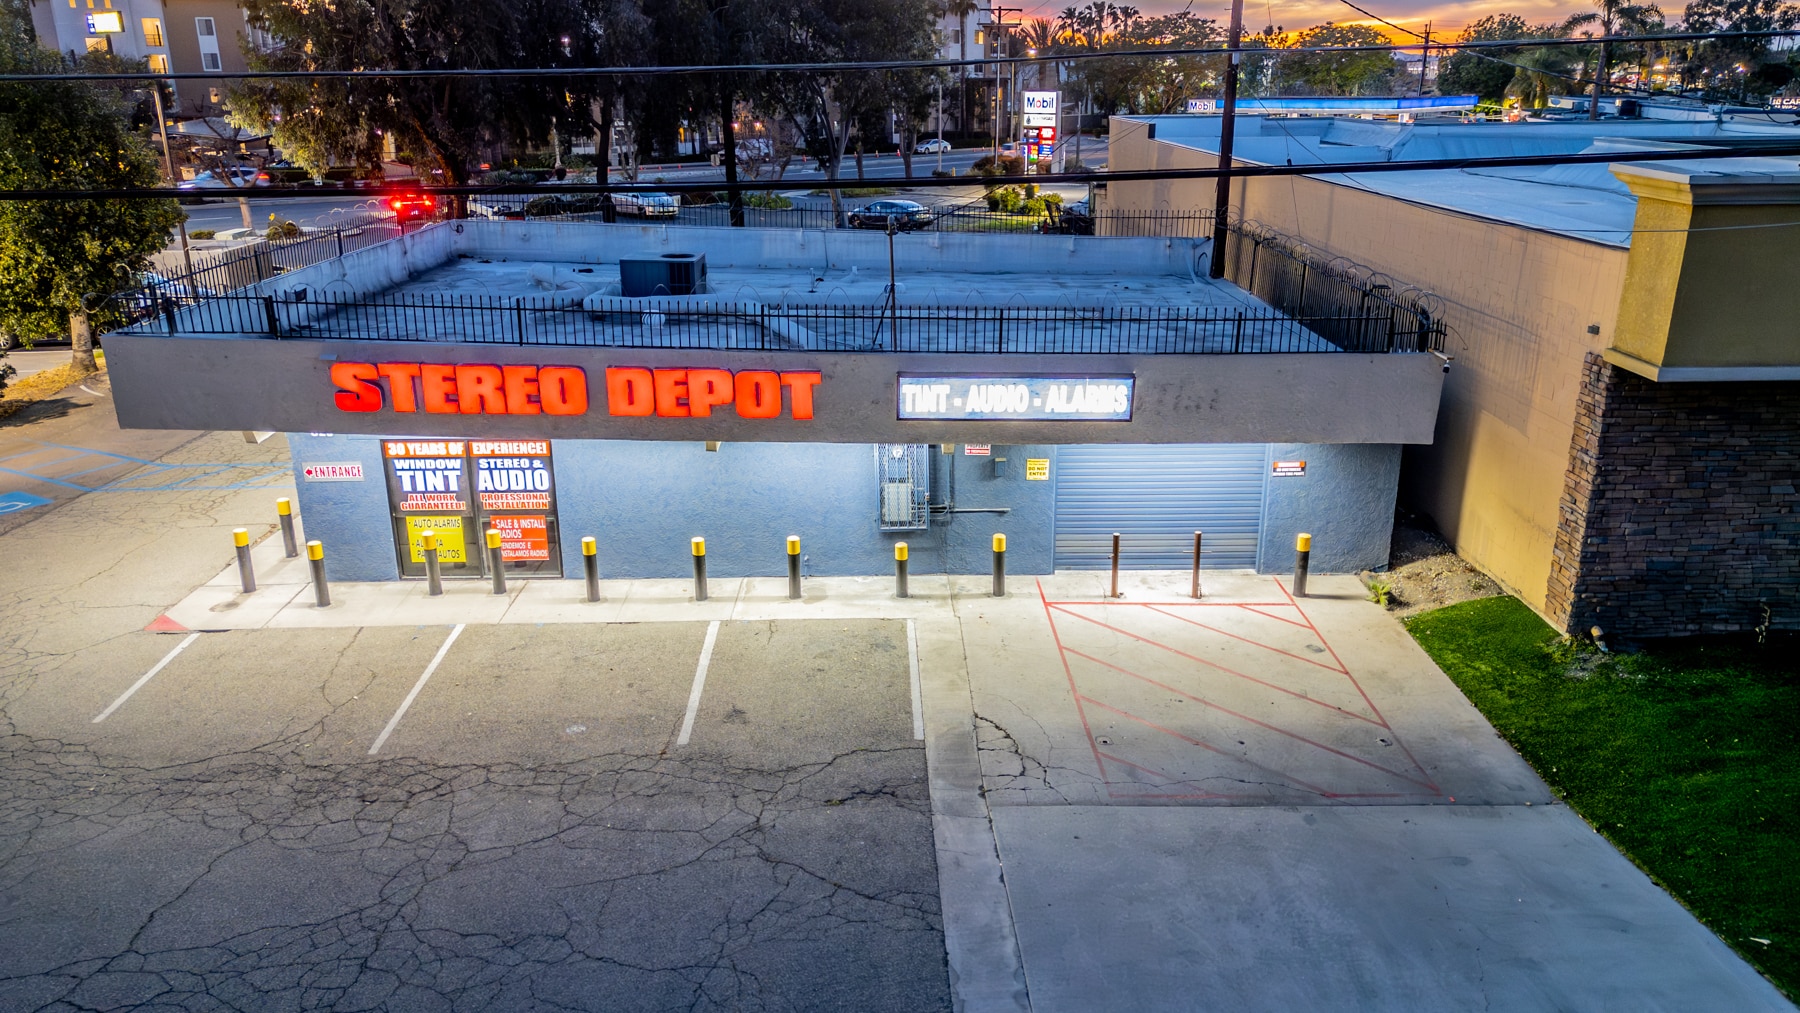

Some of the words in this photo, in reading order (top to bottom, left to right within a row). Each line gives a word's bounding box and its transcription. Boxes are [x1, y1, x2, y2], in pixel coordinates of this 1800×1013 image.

[1026, 97, 1054, 109] Mobil
[1190, 101, 1214, 111] Mobil
[330, 362, 588, 415] STEREO
[605, 366, 823, 420] DEPOT
[902, 384, 951, 413] TINT
[965, 384, 1030, 413] AUDIO
[1044, 384, 1128, 413] ALARMS
[387, 442, 406, 456] 30
[406, 442, 447, 456] YEARS
[447, 442, 464, 455] OF
[472, 441, 548, 455] EXPERIENCE!
[393, 458, 462, 470] WINDOW
[478, 458, 530, 469] STEREO
[532, 459, 544, 468] &
[314, 465, 363, 478] ENTRANCE
[396, 469, 461, 492] TINT
[478, 469, 550, 491] AUDIO
[408, 494, 424, 502] ALL
[425, 493, 457, 502] WORK
[480, 492, 551, 502] PROFESSIONAL
[401, 501, 466, 510] GUARANTEED!
[483, 501, 549, 510] INSTALLATION
[413, 519, 432, 528] AUTO
[434, 519, 460, 528] ALARMS
[496, 519, 513, 529] SALE
[513, 519, 519, 528] &
[520, 519, 547, 528] INSTALL
[502, 541, 526, 549] ENDEMOS
[527, 541, 532, 549] E
[438, 549, 460, 559] AUTOS
[530, 549, 548, 557] RADIOS
